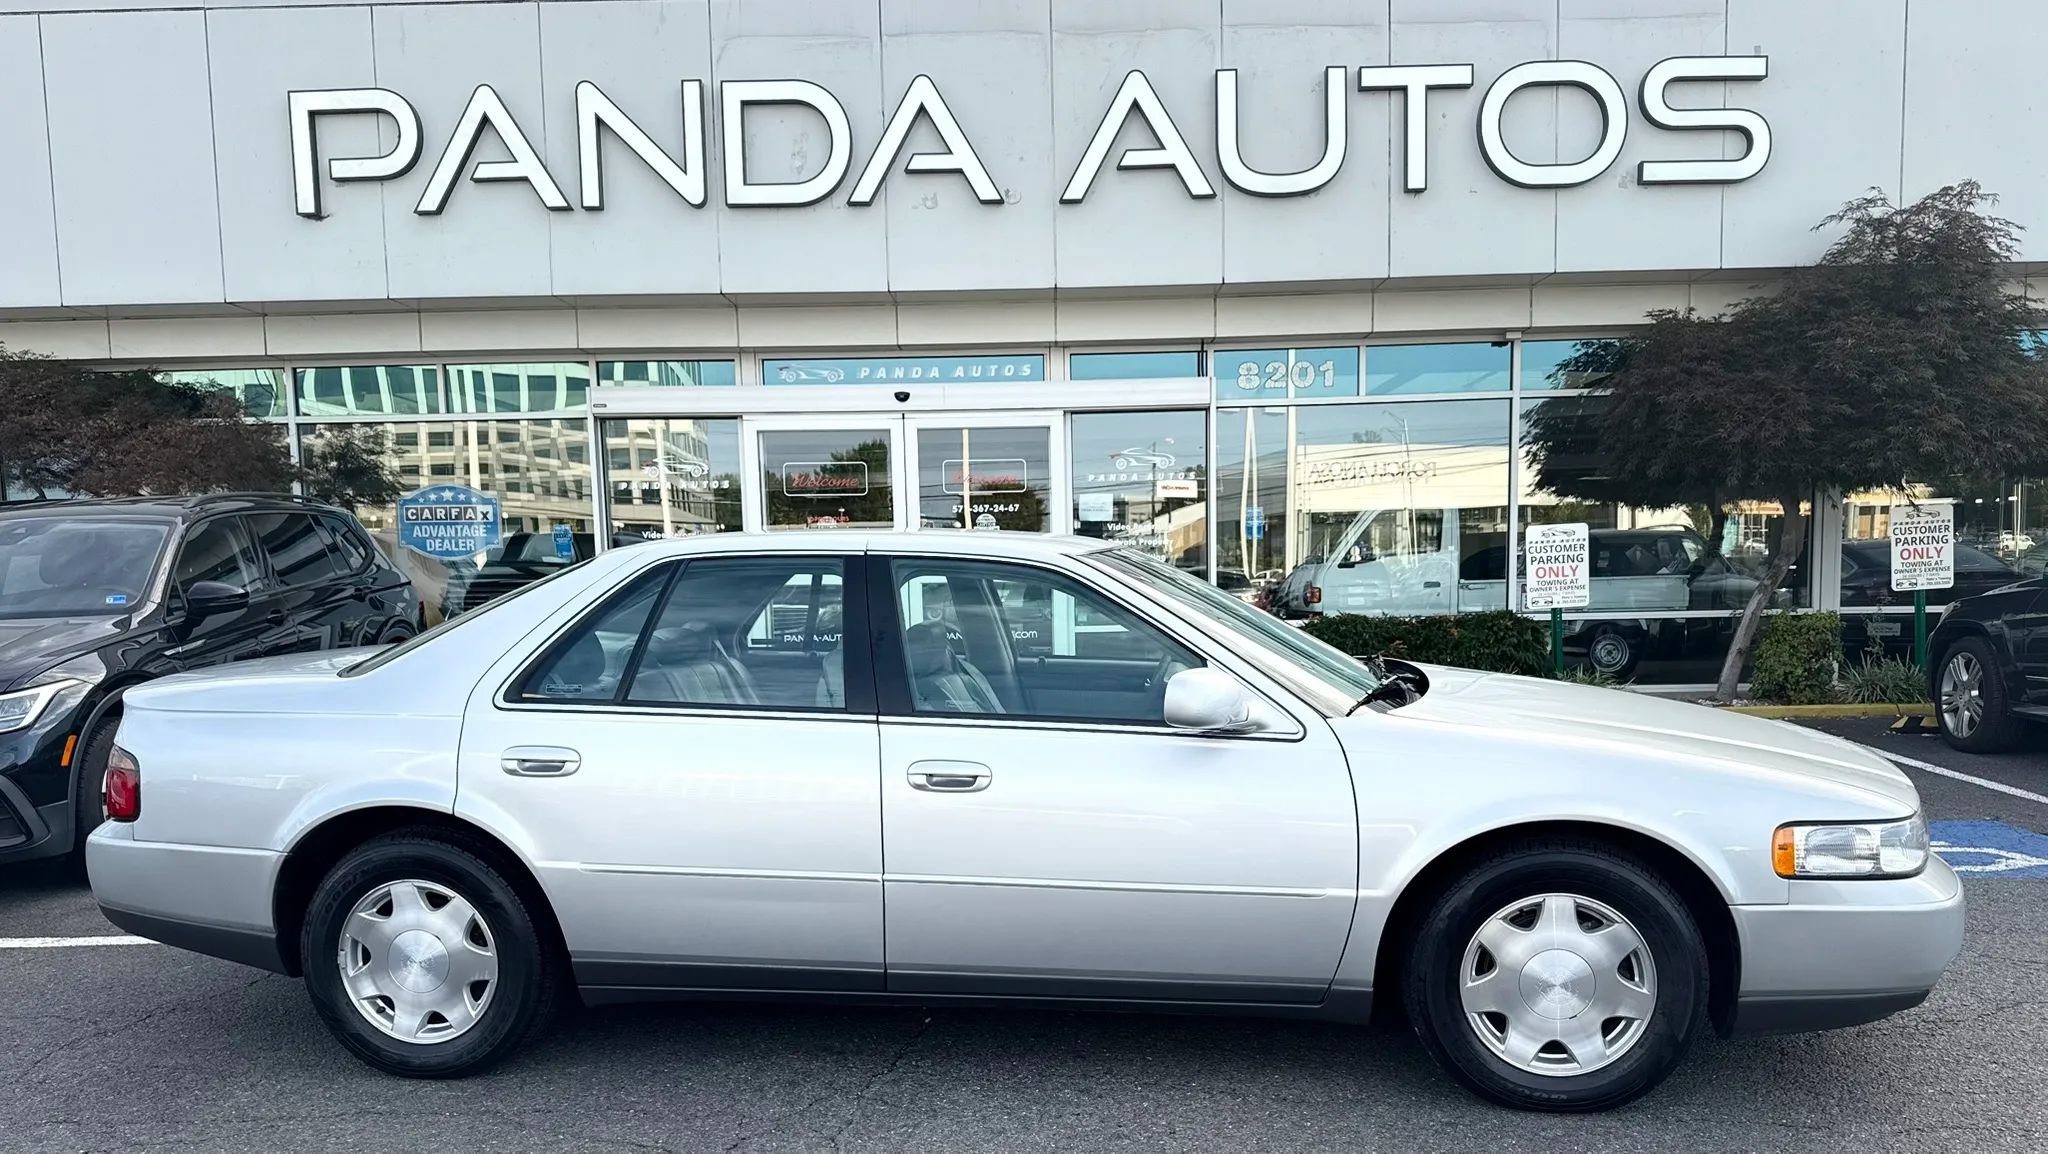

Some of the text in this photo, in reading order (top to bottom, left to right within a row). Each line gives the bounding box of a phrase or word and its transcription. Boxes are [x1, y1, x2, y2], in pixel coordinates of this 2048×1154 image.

[287, 55, 1772, 216] PANDA AUTOS
[859, 364, 1032, 379] PANDA AUTOS
[1237, 359, 1335, 390] 8201
[792, 472, 859, 488] Welcome
[1088, 471, 1196, 482] PANDA AUTOS
[680, 480, 730, 490] AUTOS
[405, 506, 491, 521] CARFAX
[952, 503, 1020, 513] 57-367-24-67
[1107, 522, 1132, 531] Video
[1892, 524, 1951, 536] CUSTOMER
[425, 538, 475, 551] DEALER
[1895, 534, 1949, 547] PARKING
[1528, 543, 1586, 555] CUSTOMER
[1899, 546, 1944, 561] ONLY
[1530, 553, 1584, 566] PARKING
[1900, 560, 1932, 568] TOWING
[1535, 565, 1579, 579] ONLY
[1536, 579, 1568, 587] TOWING
